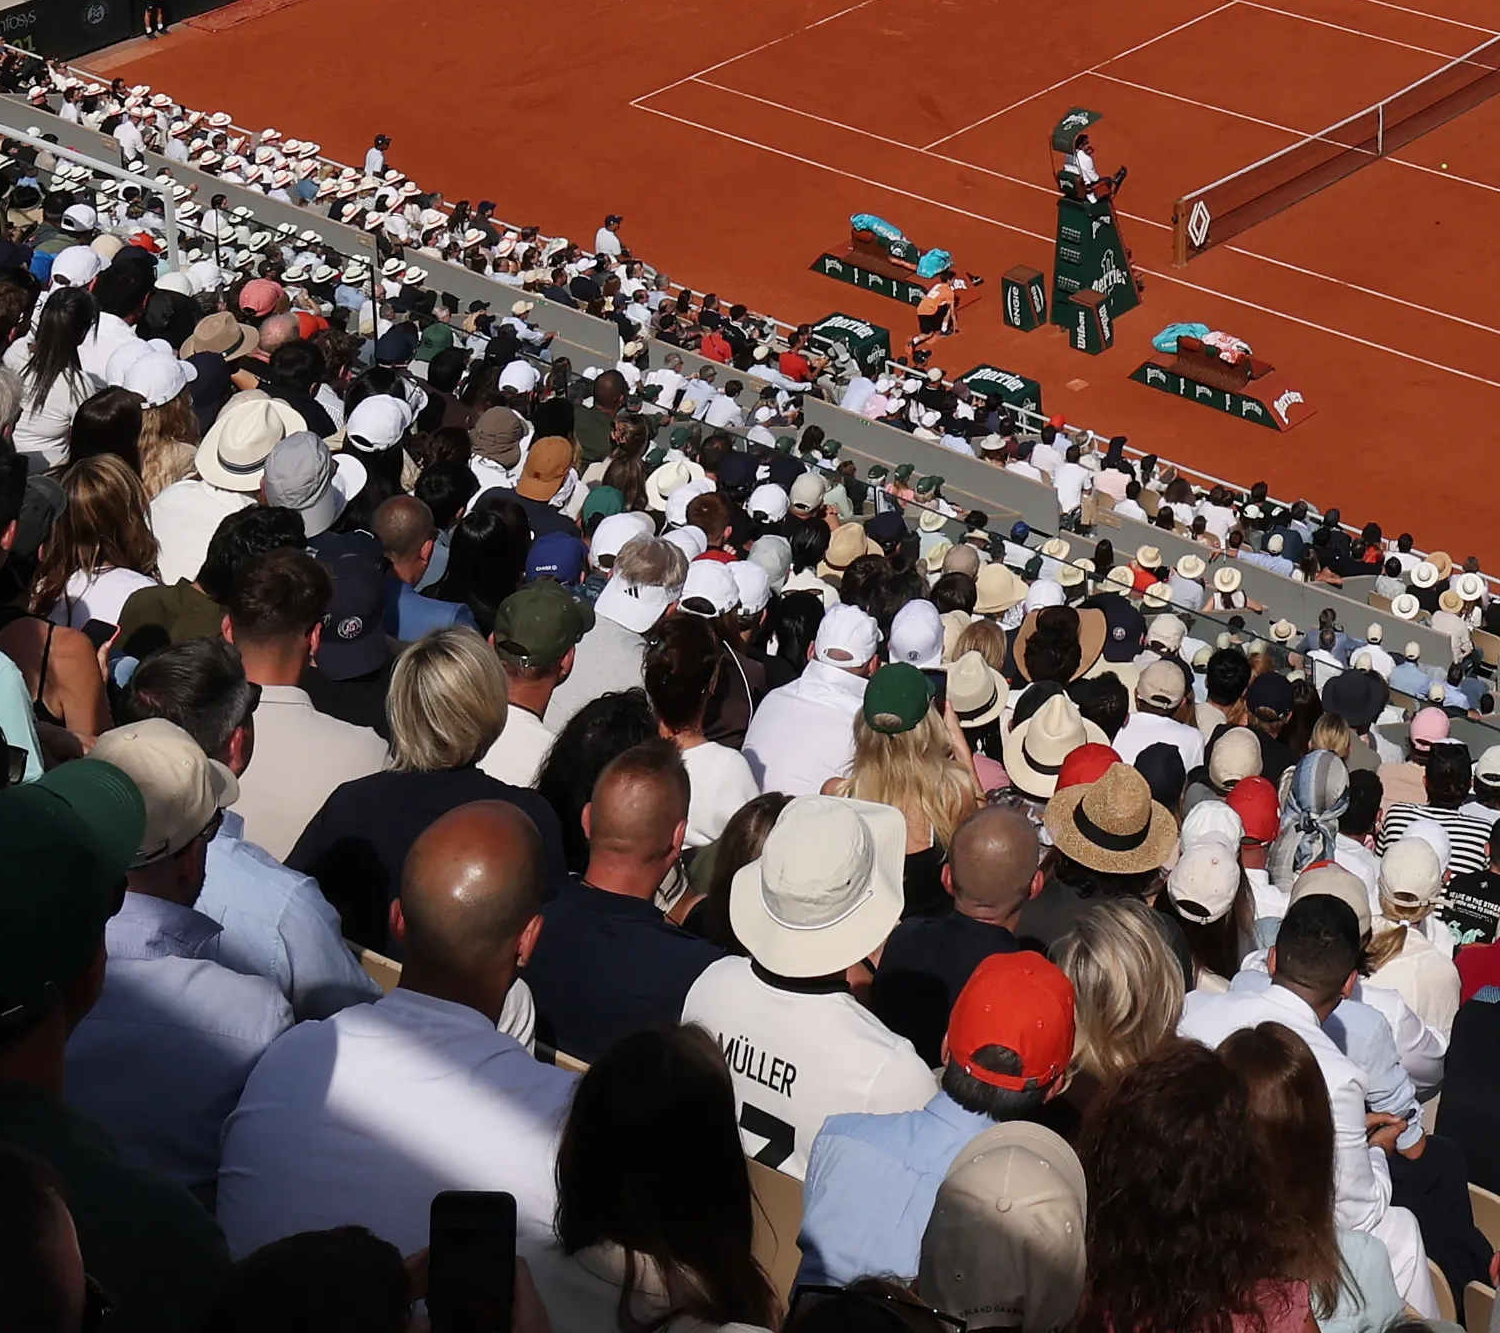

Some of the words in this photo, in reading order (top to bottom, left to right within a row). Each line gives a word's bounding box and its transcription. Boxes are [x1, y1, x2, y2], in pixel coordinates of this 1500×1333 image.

[812, 315, 876, 340] Perrier
[1076, 310, 1087, 350] Wilson
[1099, 303, 1111, 341] Wilson
[963, 366, 1025, 393] Perrier
[1273, 389, 1305, 425] Perrier
[717, 1032, 797, 1098] MÜLLER
